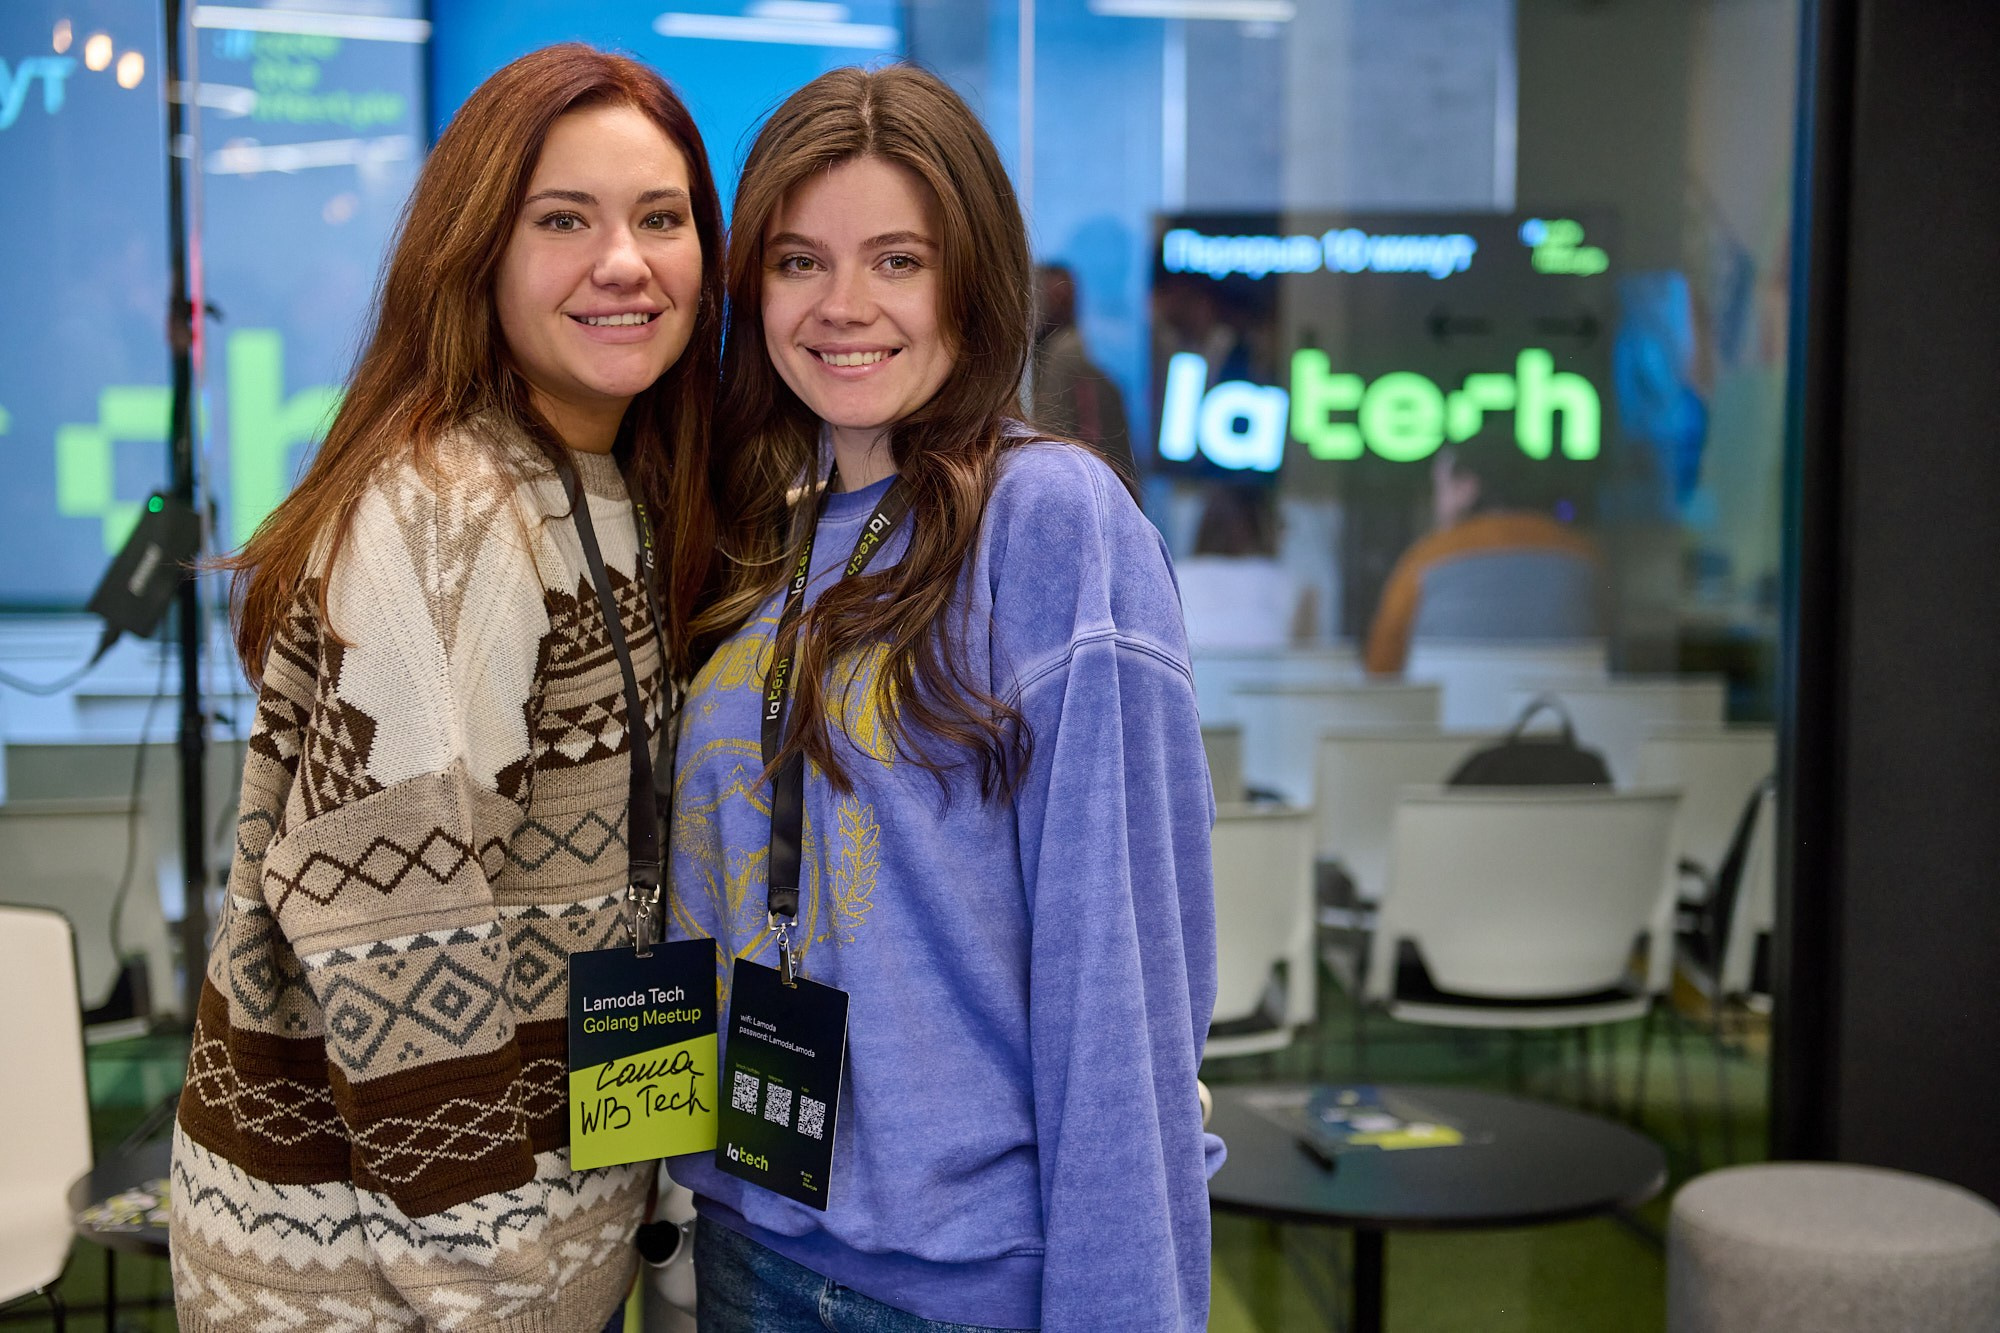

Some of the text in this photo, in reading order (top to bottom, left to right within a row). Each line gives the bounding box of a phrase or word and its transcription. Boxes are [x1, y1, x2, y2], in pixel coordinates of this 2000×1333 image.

[847, 512, 892, 576] latech
[766, 658, 789, 720] latech
[583, 985, 685, 1012] Lamoda Tech
[583, 1008, 702, 1034] Golang Meetup
[753, 1017, 777, 1033] Lamoda
[739, 1026, 816, 1058] password: LamodaLamoda
[581, 1075, 711, 1136] WB Tech
[726, 1142, 769, 1172] latech
